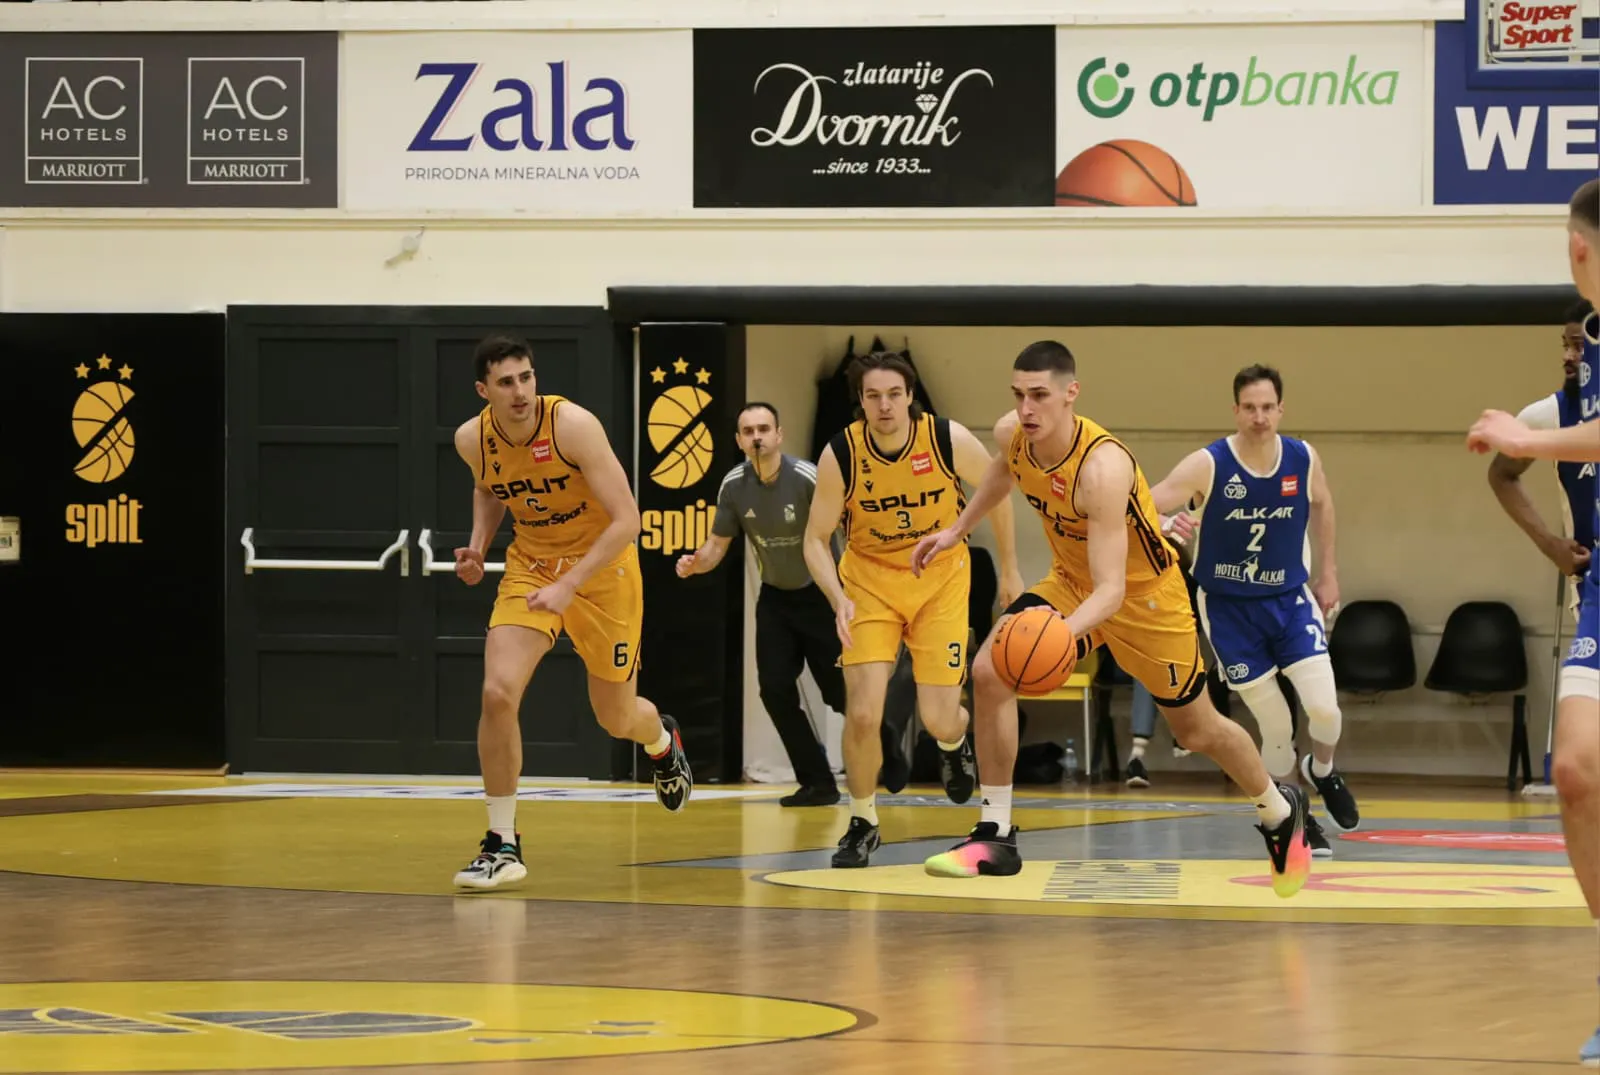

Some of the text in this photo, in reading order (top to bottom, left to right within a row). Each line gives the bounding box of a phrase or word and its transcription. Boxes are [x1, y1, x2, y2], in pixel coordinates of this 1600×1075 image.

[1500, 2, 1577, 25] Super
[1503, 24, 1573, 49] Sport
[842, 61, 944, 89] zlatarije
[41, 75, 127, 121] AC
[203, 75, 289, 121] AC
[406, 60, 640, 152] Zala
[751, 63, 994, 146] Dvornik
[40, 127, 127, 142] HOTELS
[202, 128, 289, 142] HOTELS
[1455, 106, 1599, 171] WE
[42, 163, 127, 178] MARRIOTT
[204, 164, 289, 178] MARRIOTT
[405, 166, 641, 181] PRIRODNA MINERALNA VODA
[491, 474, 571, 501] SPLIT
[859, 487, 946, 513] SPLIT
[65, 493, 144, 548] split
[896, 510, 912, 530] 3
[1026, 493, 1079, 524] PLIT
[1224, 506, 1294, 520] ALKAR
[1246, 523, 1266, 552] 2
[1215, 563, 1242, 578] HOTEL
[1305, 623, 1328, 651] 2
[614, 642, 629, 668] 6
[947, 641, 962, 669] 3
[1168, 662, 1179, 688] 1
